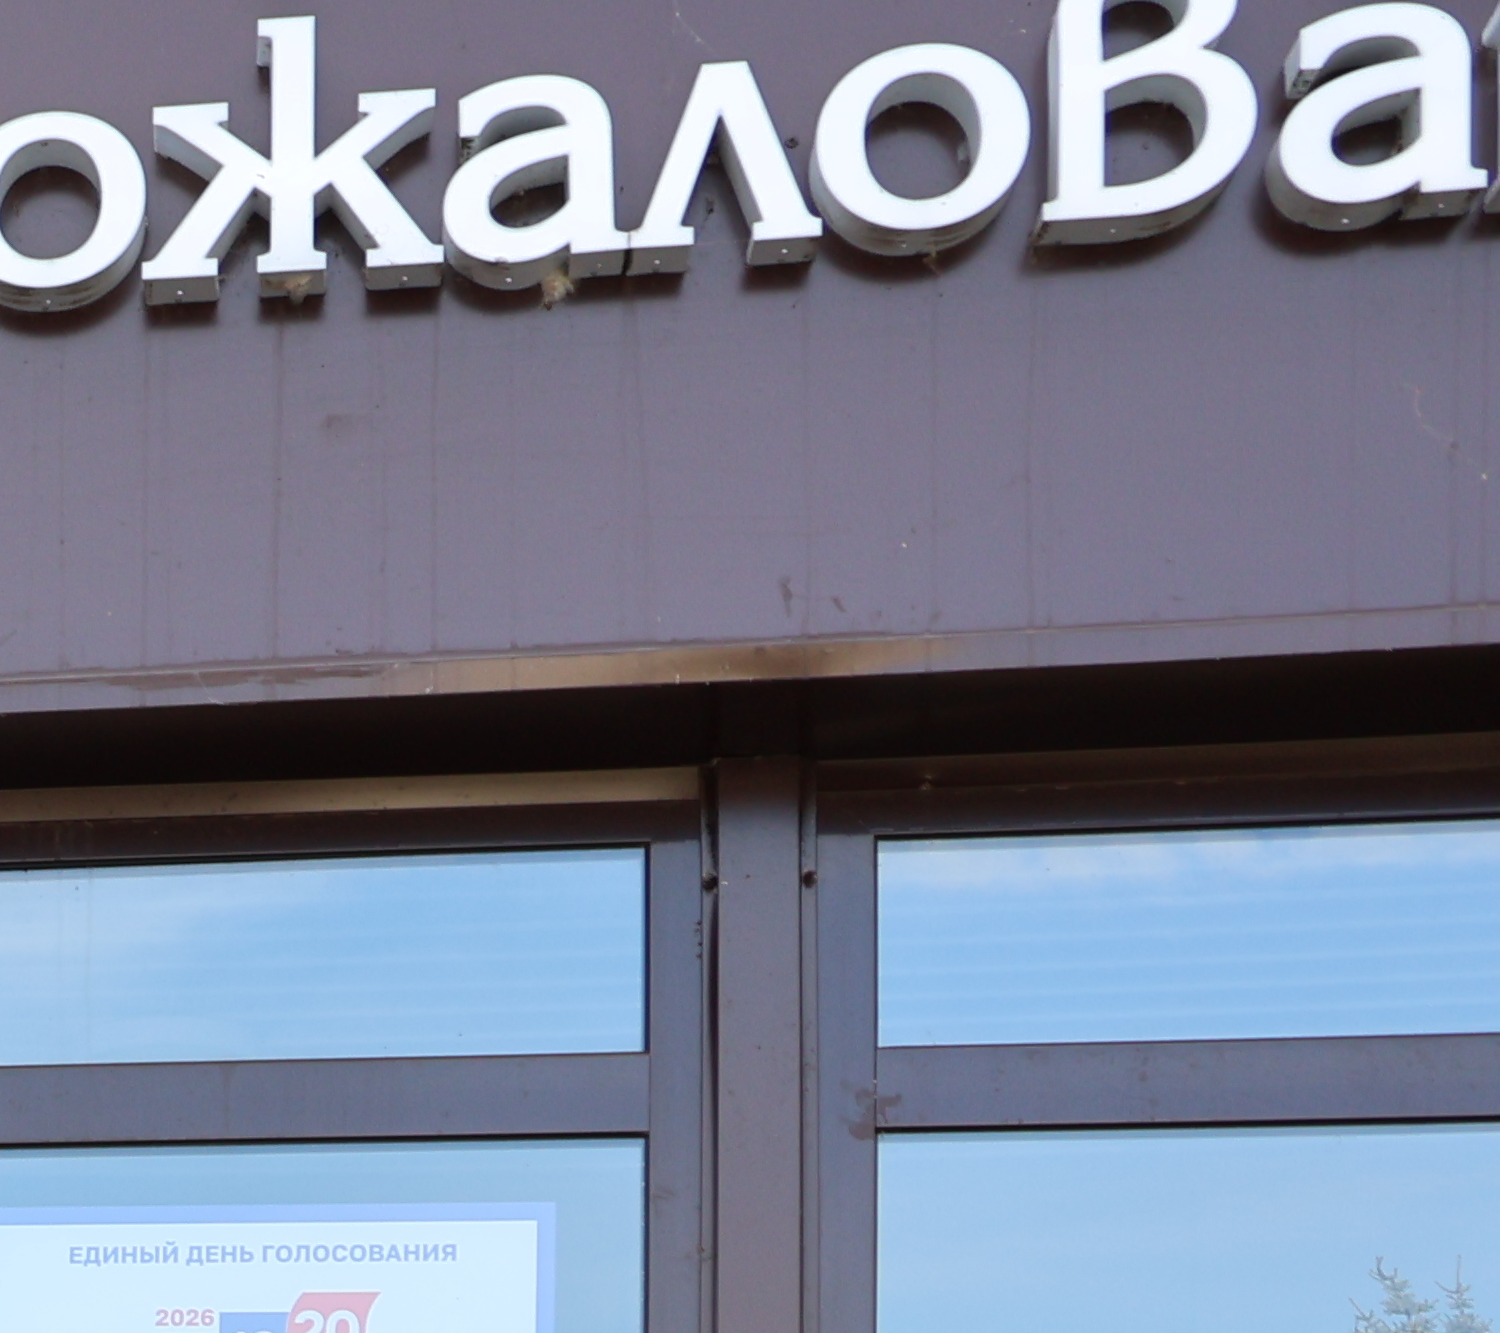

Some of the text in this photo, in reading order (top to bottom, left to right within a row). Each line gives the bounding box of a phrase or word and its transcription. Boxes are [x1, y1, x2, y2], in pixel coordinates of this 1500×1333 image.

[68, 1241, 458, 1266] ЕДИНЫЙ ДЕНЬ ГОЛОСОВАНИЯ
[155, 1308, 214, 1327] 2026
